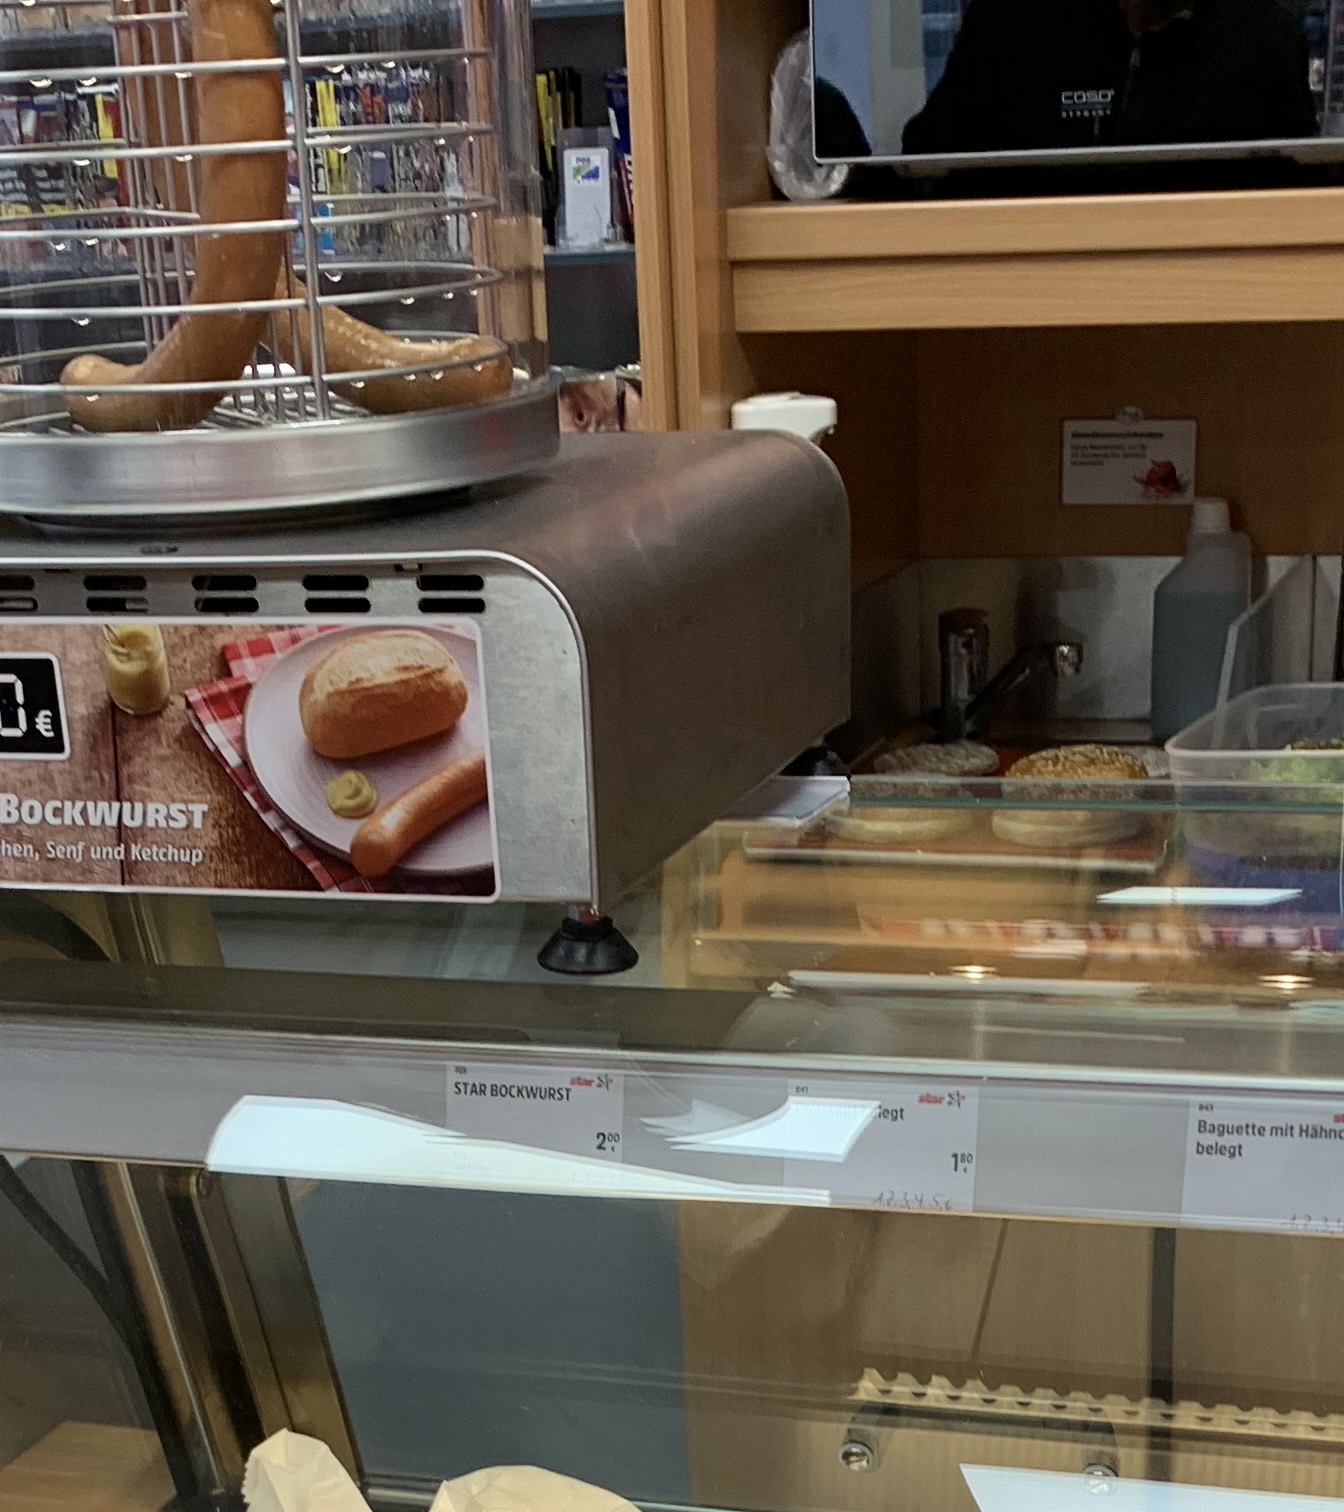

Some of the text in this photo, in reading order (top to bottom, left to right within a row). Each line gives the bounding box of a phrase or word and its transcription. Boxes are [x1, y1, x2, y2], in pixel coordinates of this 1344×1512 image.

[46, 841, 85, 864] Senf
[90, 842, 125, 861] und
[131, 842, 203, 866] Ketchup
[454, 1081, 572, 1101] STAR BOCKWURST
[1197, 1119, 1266, 1139] Baguette
[1270, 1123, 1294, 1139] mit
[1196, 1141, 1243, 1160] belegt
